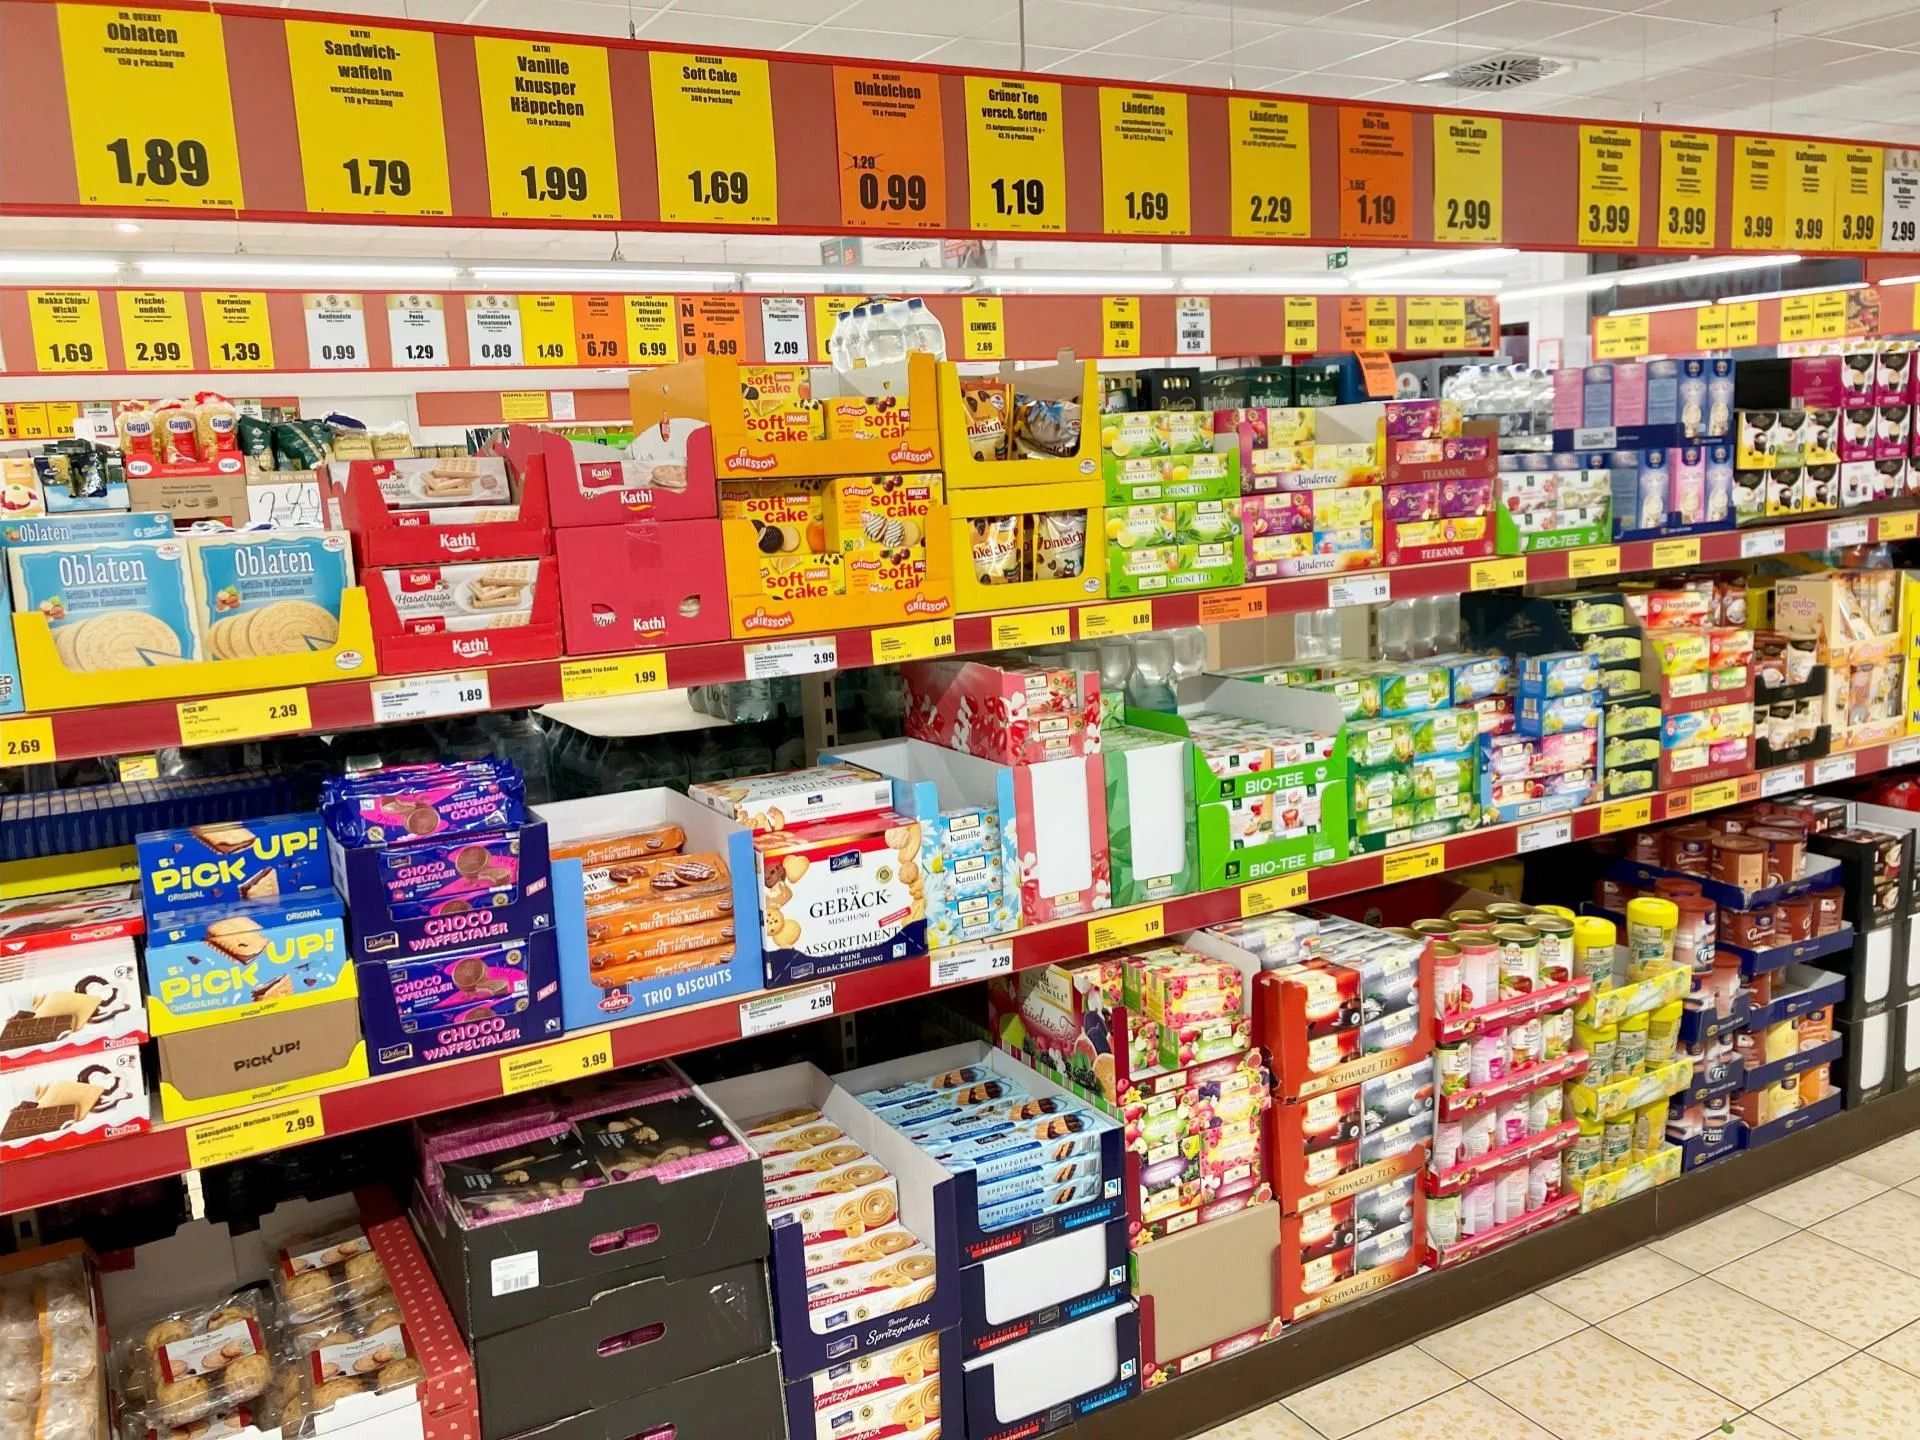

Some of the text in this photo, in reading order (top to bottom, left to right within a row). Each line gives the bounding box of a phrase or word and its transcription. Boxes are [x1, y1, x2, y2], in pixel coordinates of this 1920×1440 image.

[107, 22, 178, 44] Oblaten
[324, 40, 401, 60] Sandwich-
[118, 58, 131, 67] 150
[140, 60, 174, 69] Packung
[338, 64, 392, 81] waffeln
[517, 56, 570, 75] Vanille
[682, 66, 738, 83] Soft Cake
[514, 76, 576, 96] Knusper
[854, 81, 921, 99] Dinkelchen
[988, 88, 1039, 103] Grüner Tee
[510, 96, 585, 116] Häppchen
[981, 106, 1048, 122] versch. Sorten
[1122, 101, 1165, 116] Ländertee
[526, 118, 537, 126] 150
[106, 138, 209, 187] 1,89
[343, 158, 412, 197] 1,79
[521, 165, 588, 202] 1,99
[688, 170, 749, 205] 1,69
[859, 173, 927, 211] 0,99
[991, 178, 1044, 215] 1,19
[1125, 191, 1169, 221] 1,69
[1250, 195, 1292, 223] 2,29
[1357, 194, 1395, 225] 1,19
[1447, 198, 1490, 229] 2,99
[1589, 204, 1630, 234] 3,99
[1669, 206, 1705, 235] 3,99
[1744, 215, 1773, 238] 3,99
[1843, 214, 1875, 240] 3,99
[1796, 217, 1823, 240] 3,99
[1892, 221, 1916, 241] 2,99
[970, 322, 997, 332] EINWEG
[1110, 321, 1134, 329] EINWEG
[49, 343, 93, 362] 1,69
[136, 342, 181, 361] 2,99
[220, 343, 260, 361] 1,39
[322, 345, 356, 360] 0,99
[405, 344, 434, 359] 1,29
[481, 344, 512, 358] 0,89
[537, 344, 564, 358] 1,49
[587, 340, 617, 356] 6,79
[639, 342, 667, 356] 6,99
[707, 340, 737, 355] 4,99
[774, 342, 798, 354] 2,09
[760, 383, 791, 393] cake
[747, 414, 809, 430] soft ORANGE
[864, 412, 898, 427] soft
[764, 427, 808, 442] cake
[728, 457, 776, 470] GRIESSON
[890, 450, 933, 464] GRIESSON
[591, 468, 613, 478] Kathi
[1422, 468, 1467, 479] TEEKANNE
[843, 487, 873, 496] GRIESSON
[747, 497, 784, 512] soft
[886, 503, 928, 517] cake
[764, 508, 808, 523] cake
[20, 524, 71, 542] Oblaten
[440, 532, 478, 549] Kathi
[1536, 534, 1581, 549] BIO-TEE
[1421, 546, 1465, 559] TEEKANNE
[59, 555, 148, 586] Oblaten
[235, 547, 315, 577] Oblaten
[410, 573, 431, 583] Kathi
[766, 572, 804, 588] soft
[878, 564, 913, 579] soft
[452, 637, 490, 654] Kathi
[1245, 772, 1304, 794] BIO-TEE
[450, 802, 497, 820] CHOCO
[254, 827, 319, 861] UP!
[950, 829, 981, 843] Kamille
[399, 861, 446, 879] CHOCO
[1250, 854, 1306, 877] BIO-TEE
[387, 869, 456, 890] WAFFELTALER
[588, 871, 608, 881] TRIO
[955, 871, 987, 884] Kamille
[526, 877, 547, 896] NEU
[837, 884, 859, 895] FEINE
[167, 891, 205, 902] ORIGINAL
[809, 891, 892, 918] GEBÄCK-
[286, 908, 322, 921] ORIGINAL
[424, 910, 493, 935] CHOCO
[828, 911, 870, 925] MISCHUNG
[410, 921, 508, 951] WAFFELTALER
[962, 925, 990, 938] Kamille
[267, 928, 336, 963] UP!
[804, 926, 902, 956] ASSORTIMENT
[816, 955, 884, 974] GEBÄCKMISCHUNG
[840, 952, 861, 962] FEINE
[395, 975, 443, 994] CHOCO
[537, 981, 557, 1000] NEU
[643, 969, 732, 1007] TRIO BISCUITS
[603, 996, 629, 1008] nora
[437, 1017, 506, 1045] CHOCO
[423, 1029, 521, 1061] WAFFELTALER
[1330, 1056, 1398, 1085] SCHWARZE TEES
[985, 1152, 1044, 1173] SPRITZGEBÄCK
[1328, 1166, 1397, 1199] SCHWARZE TEES
[1323, 1272, 1391, 1305] SCHWARZE TEES
[866, 1314, 931, 1346] Spritzgebäck
[888, 1316, 908, 1327] Butter
